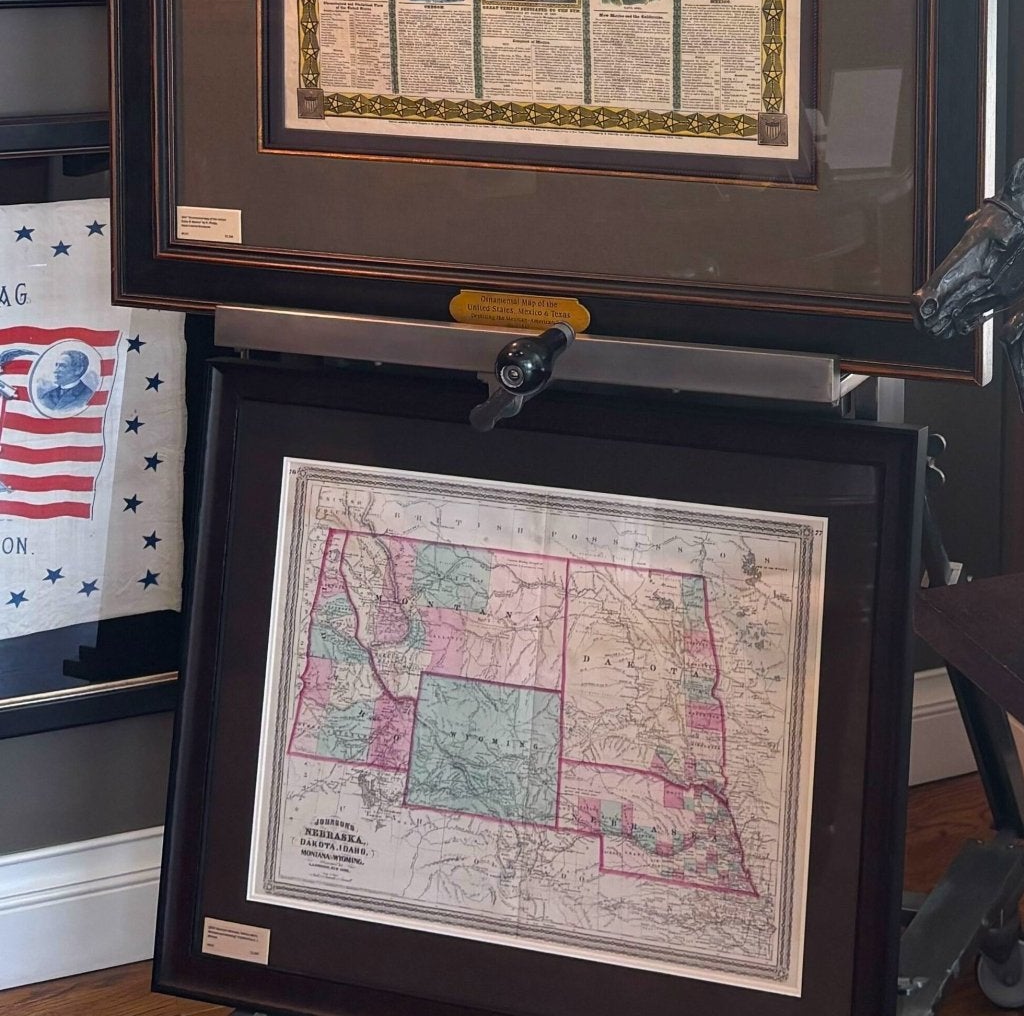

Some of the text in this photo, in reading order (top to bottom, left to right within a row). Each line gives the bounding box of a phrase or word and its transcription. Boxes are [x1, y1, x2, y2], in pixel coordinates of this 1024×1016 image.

[521, 298, 537, 308] Map
[537, 299, 546, 308] of
[546, 300, 558, 308] the
[467, 303, 491, 313] United
[551, 310, 571, 319] Texas
